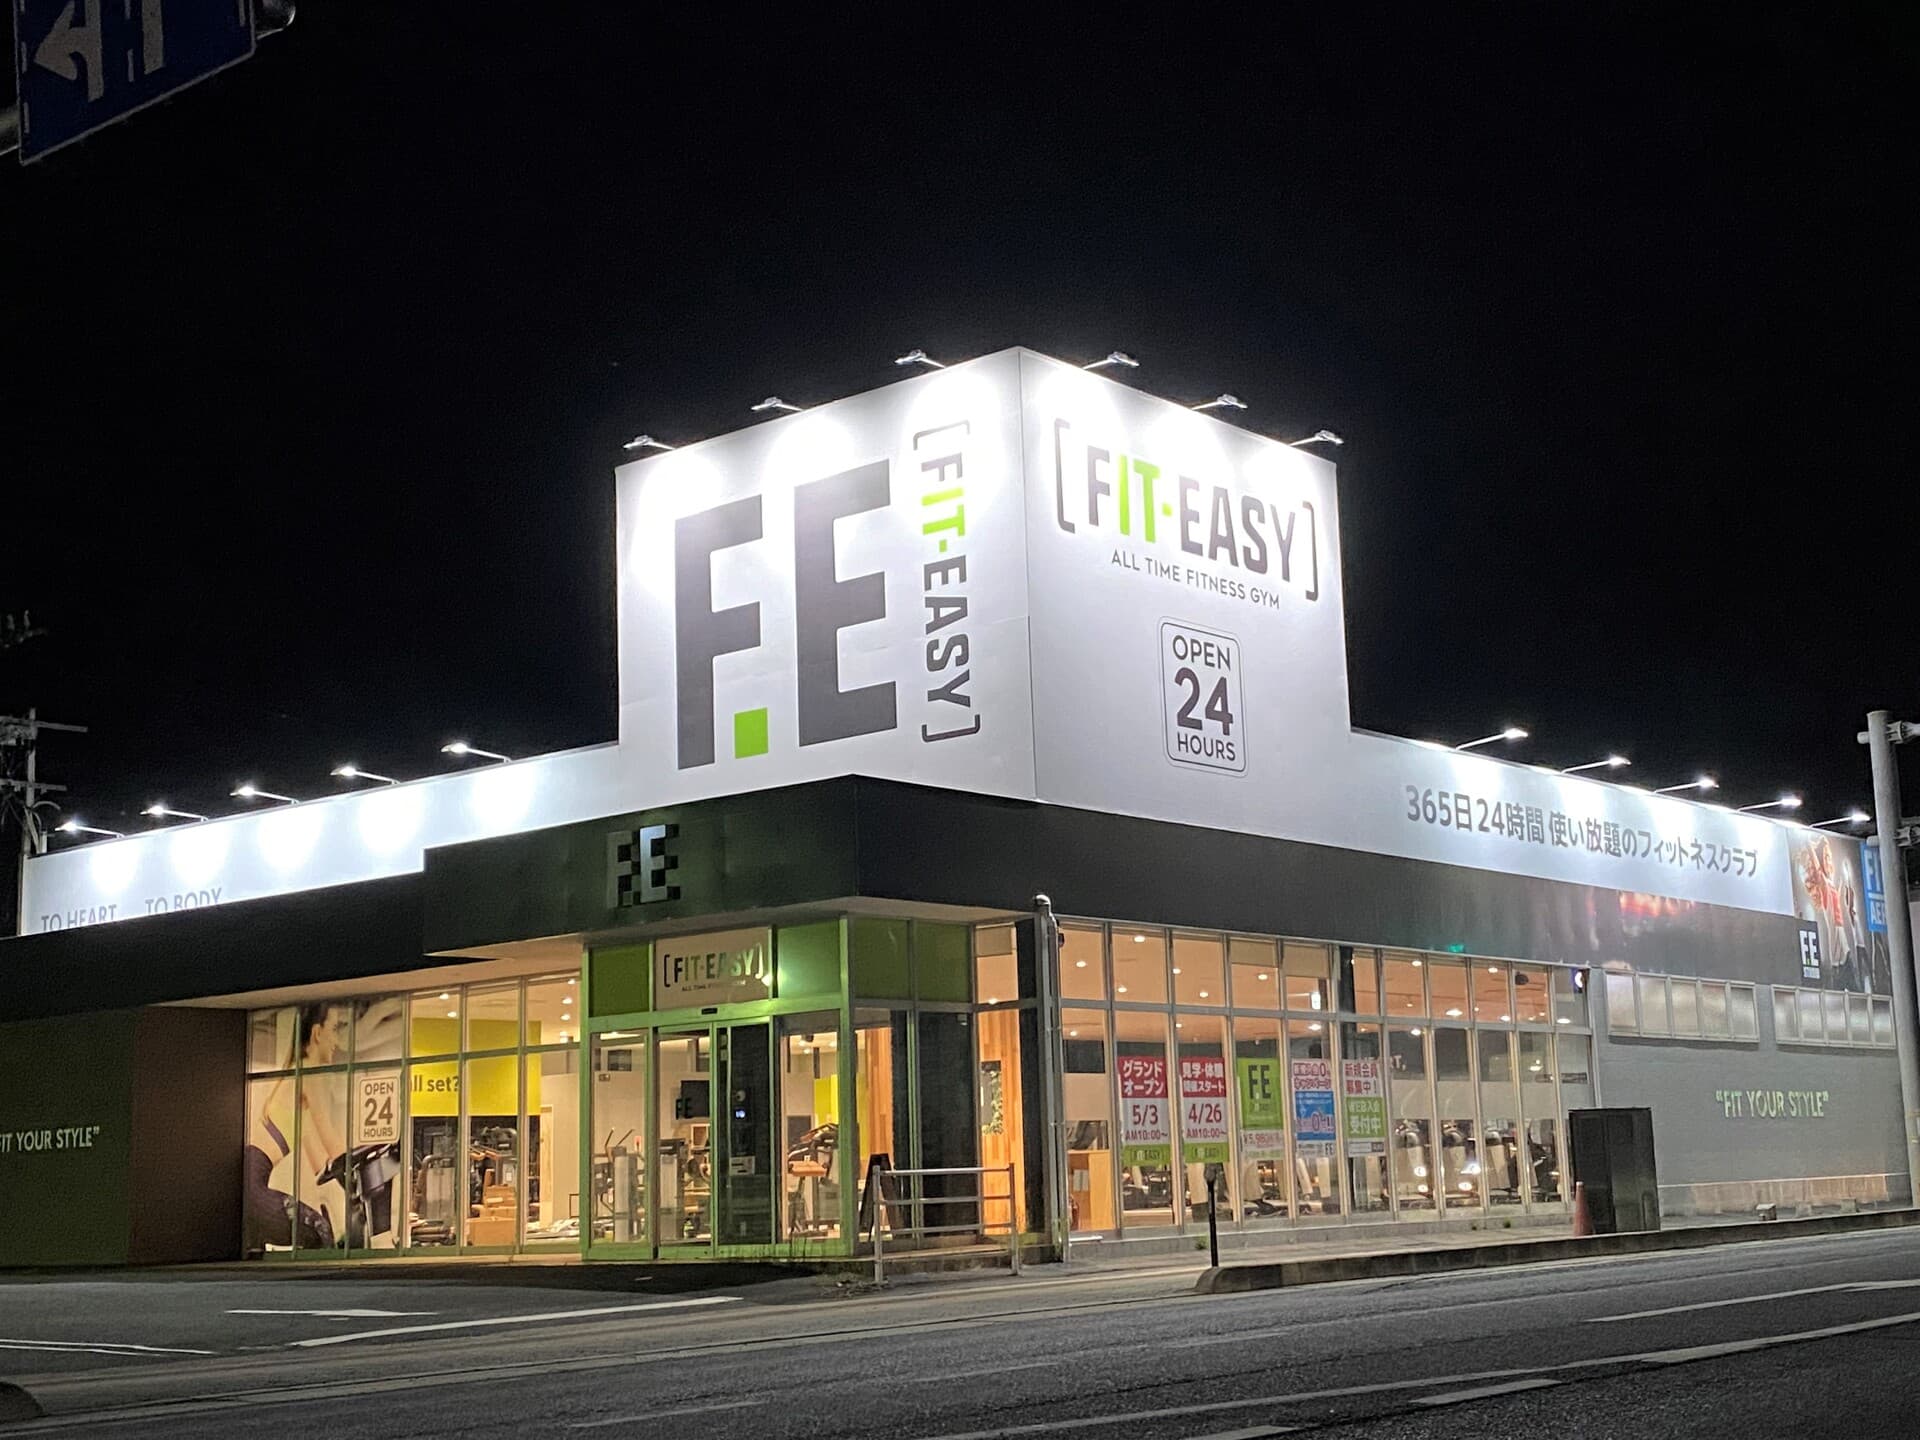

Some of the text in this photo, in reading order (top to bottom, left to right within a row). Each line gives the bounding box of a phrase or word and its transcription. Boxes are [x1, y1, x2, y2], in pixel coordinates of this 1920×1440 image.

[1111, 549, 1280, 610] ALL TIME FITNESS GYM
[1172, 634, 1231, 671] OPEN
[1174, 666, 1234, 736] 24
[1176, 732, 1236, 762] HOURS
[1405, 785, 1759, 878] 365日24時間 使い放題のフィットネスクラブ
[41, 913, 62, 932] TO
[145, 896, 168, 914] TO
[1123, 1060, 1163, 1078] グランド
[364, 1082, 394, 1096] OPEN
[427, 1075, 459, 1093] set?
[1124, 1079, 1164, 1096] オープン
[364, 1097, 393, 1126] 24
[1132, 1104, 1158, 1126] 5/3
[1188, 1103, 1222, 1124] 4/26
[1746, 1090, 1785, 1118] YOUR
[363, 1127, 393, 1138] HOURS
[1349, 1115, 1380, 1134] 受付中
[16, 1130, 52, 1152] YOUR
